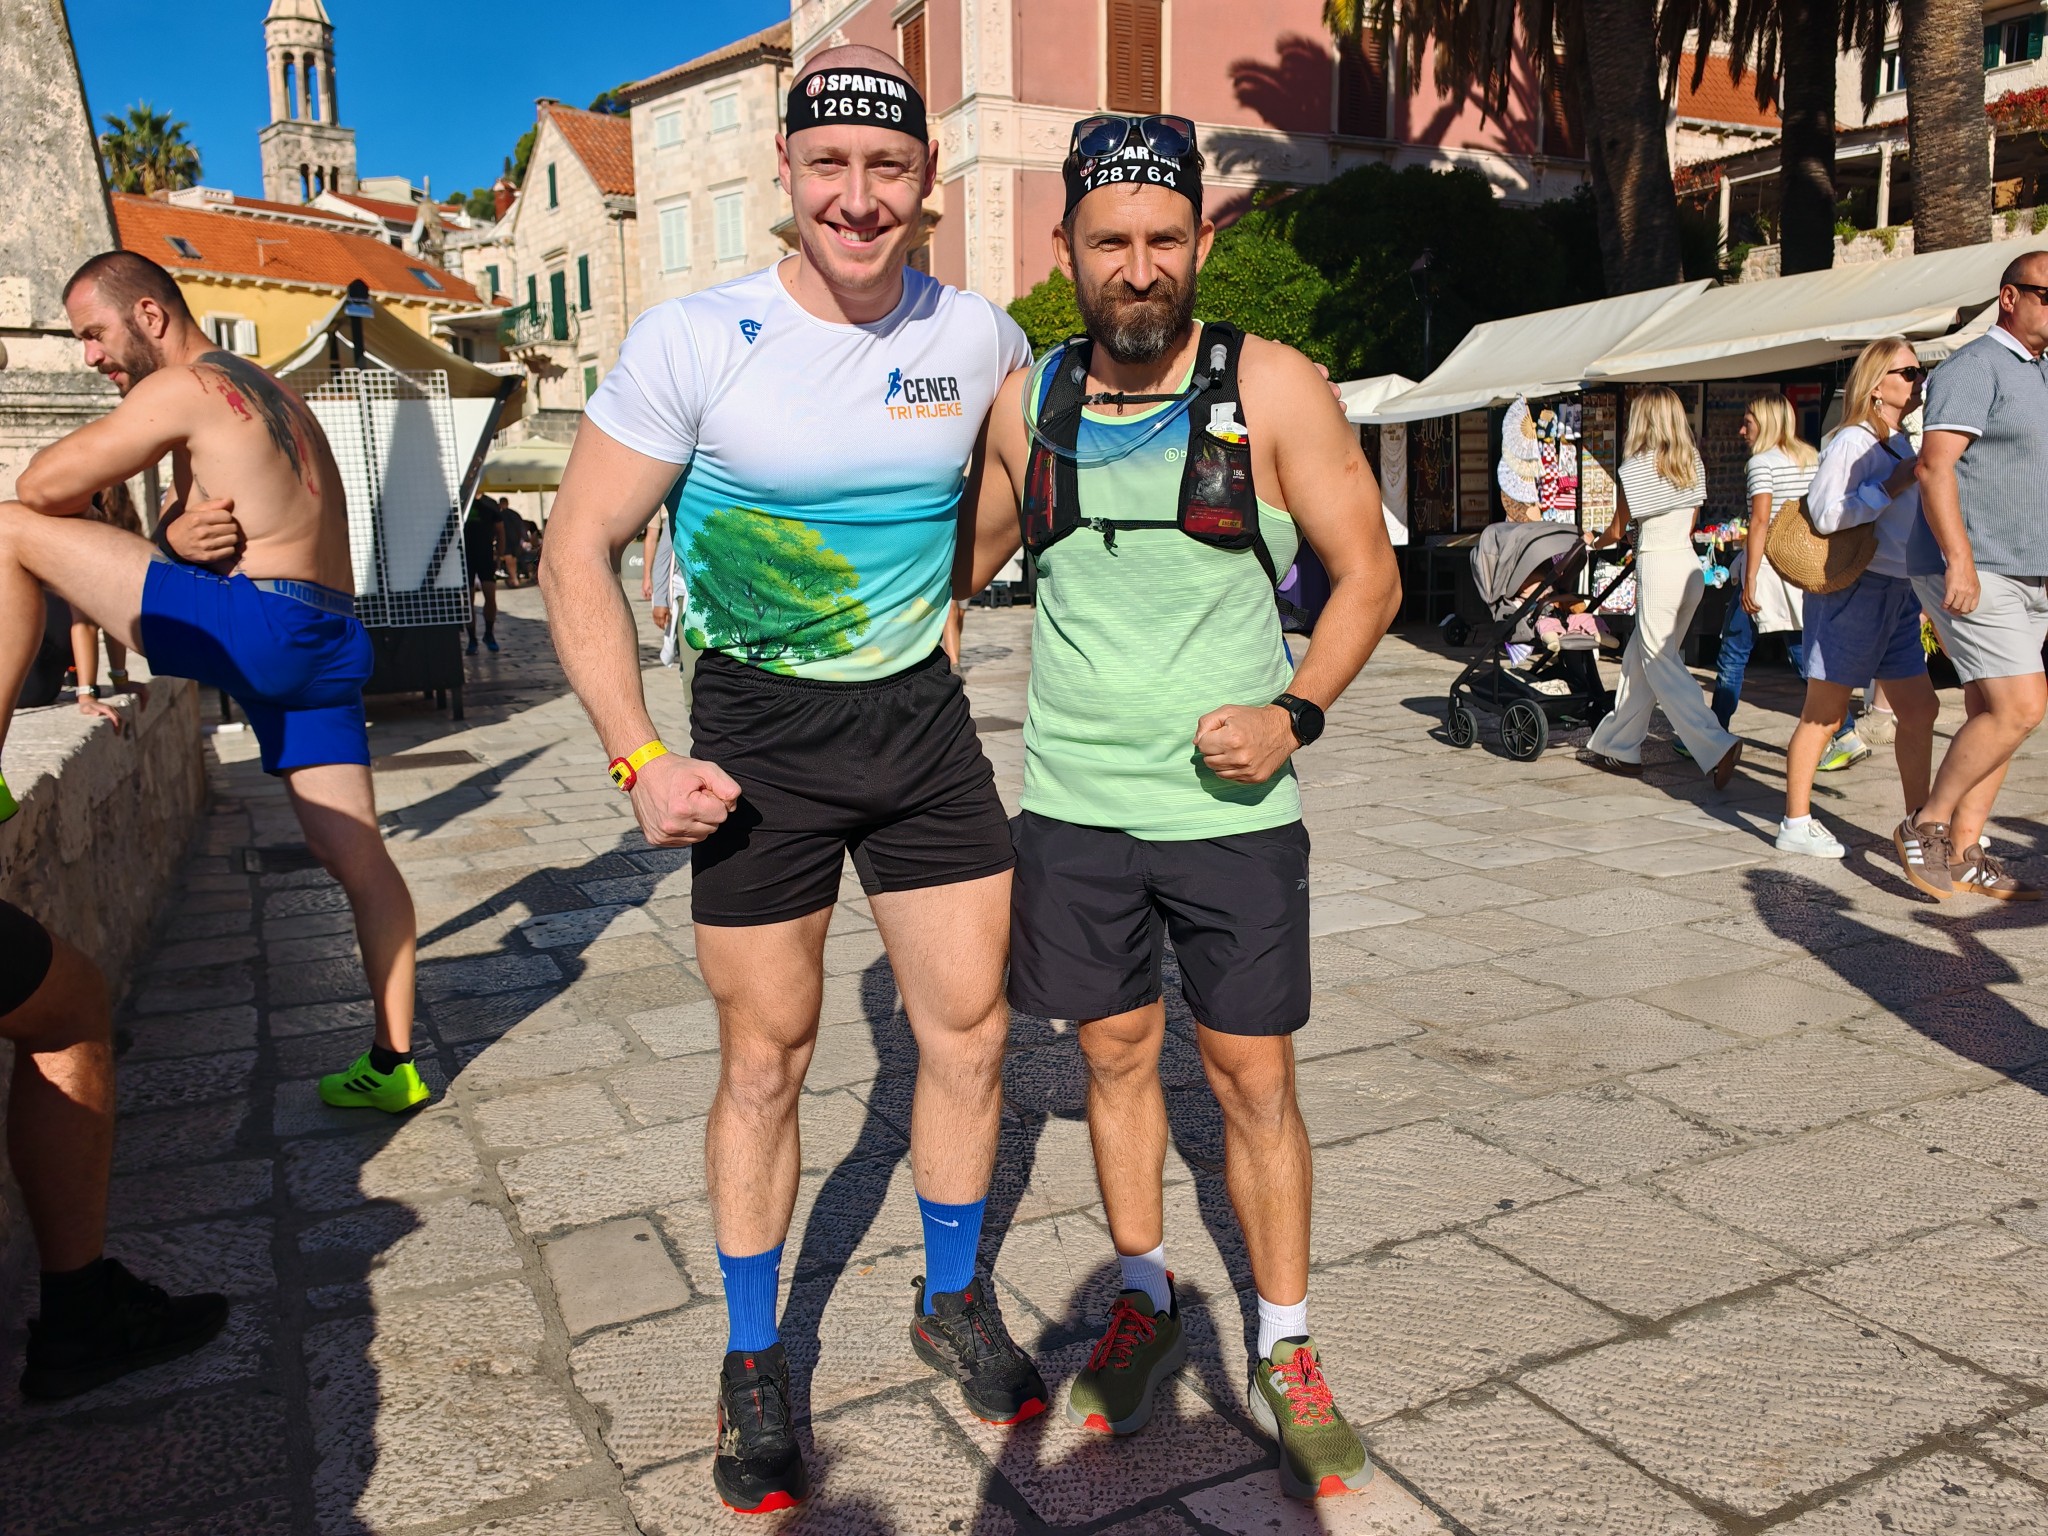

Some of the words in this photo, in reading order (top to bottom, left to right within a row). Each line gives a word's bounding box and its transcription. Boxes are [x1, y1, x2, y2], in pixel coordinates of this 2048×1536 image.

[827, 74, 907, 101] SPARTAN
[811, 98, 902, 122] 126539
[1084, 166, 1176, 191] 128764
[903, 376, 961, 404] CENER
[886, 405, 913, 420] TRI
[916, 402, 963, 419] RIJEKE
